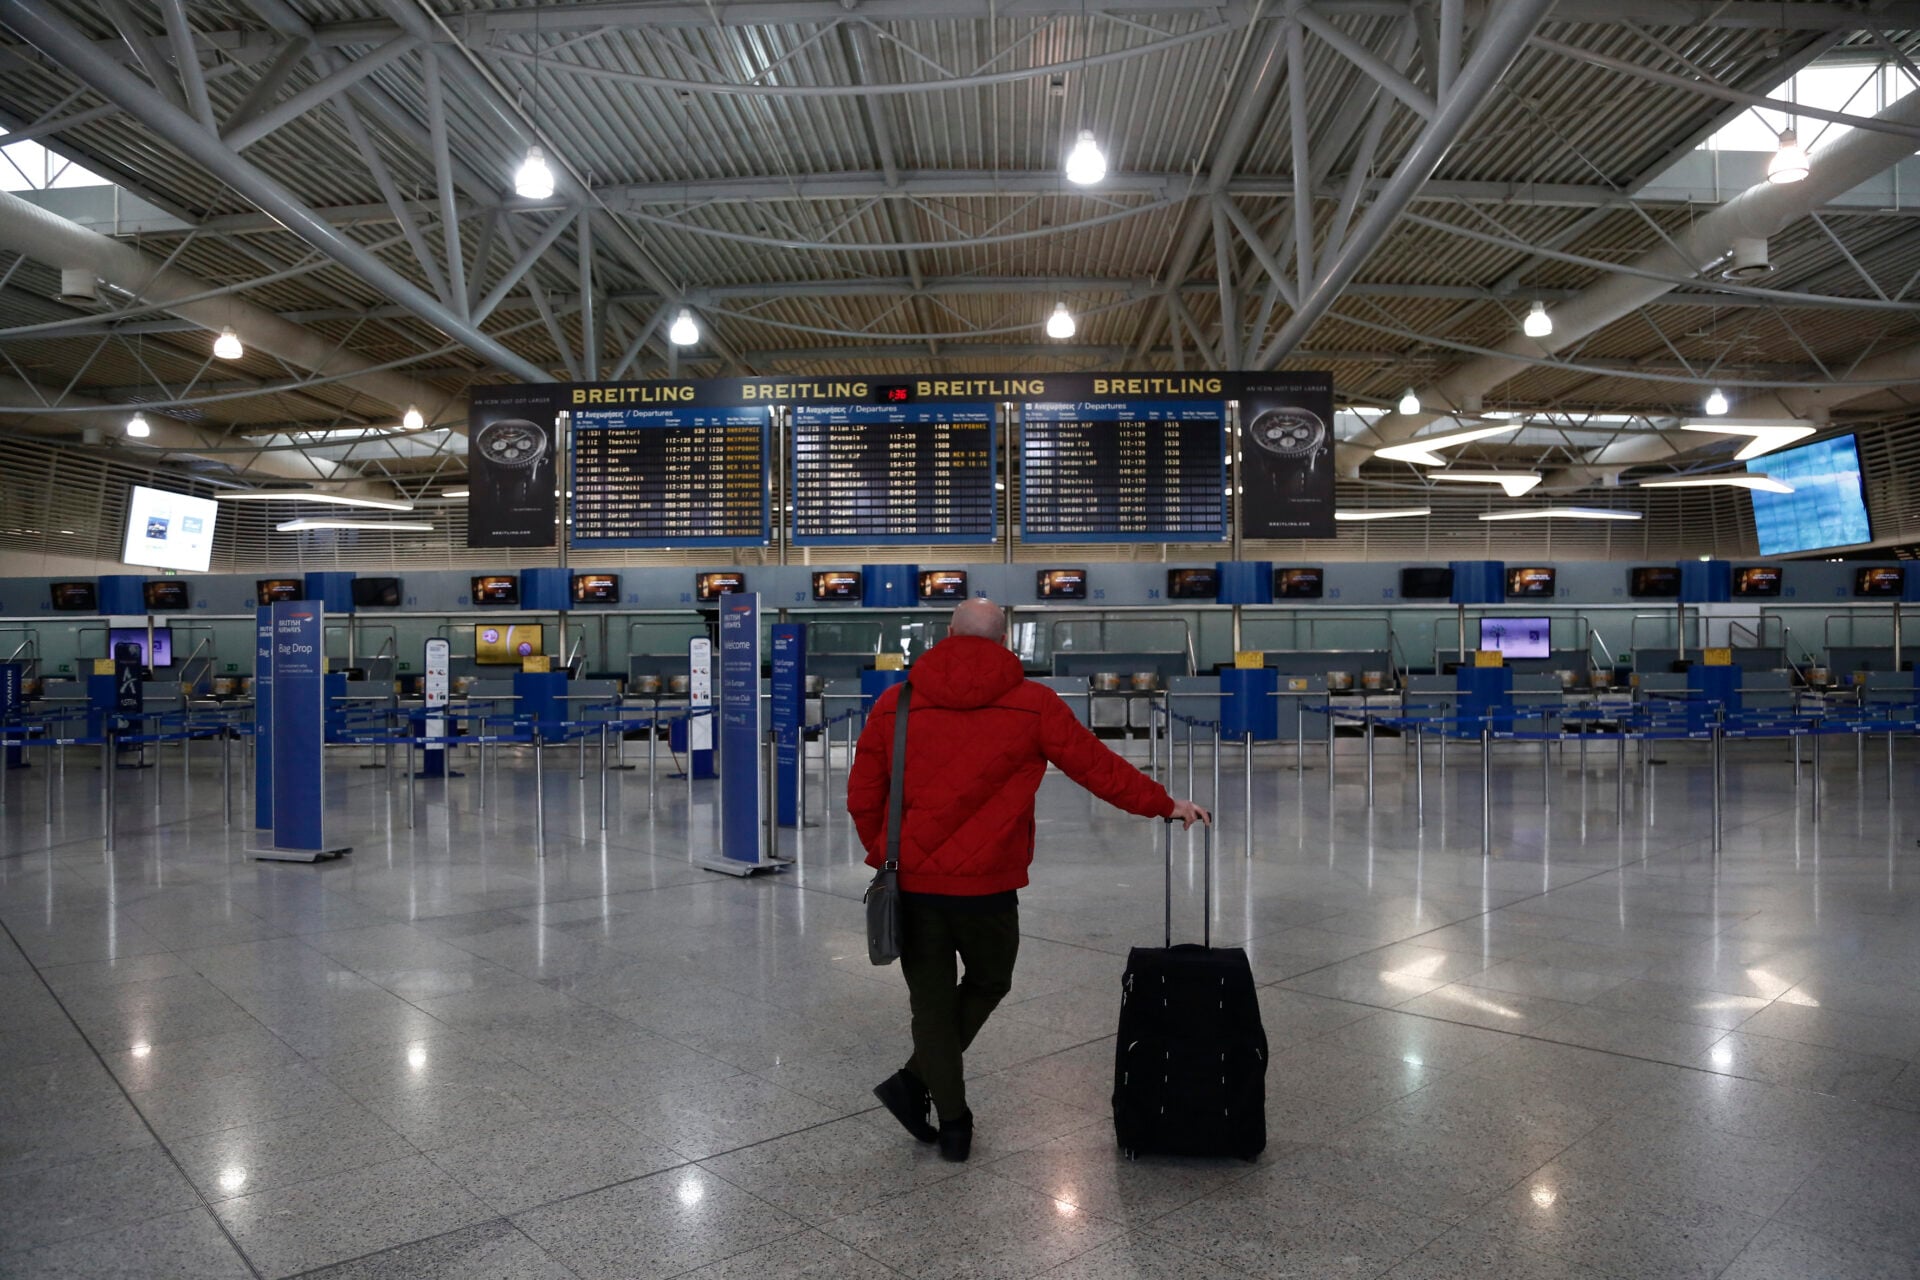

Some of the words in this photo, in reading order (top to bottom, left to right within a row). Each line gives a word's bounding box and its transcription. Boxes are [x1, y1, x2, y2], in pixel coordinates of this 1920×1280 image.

[917, 380, 1045, 396] BREITLING
[1094, 378, 1222, 394] BREITLING
[572, 387, 695, 404] BREITLING
[742, 383, 868, 400] BREITLING
[856, 405, 897, 414] Departures
[1084, 402, 1126, 412] Departures
[633, 410, 672, 419] Departures
[795, 592, 807, 602] 37
[1094, 590, 1105, 600] 35
[1148, 590, 1160, 599] 34
[40, 601, 51, 610] 44
[244, 598, 256, 608] 42
[407, 596, 417, 606] 41
[278, 644, 291, 655] Bag
[292, 644, 313, 656] Drop
[724, 641, 751, 650] Welcome
